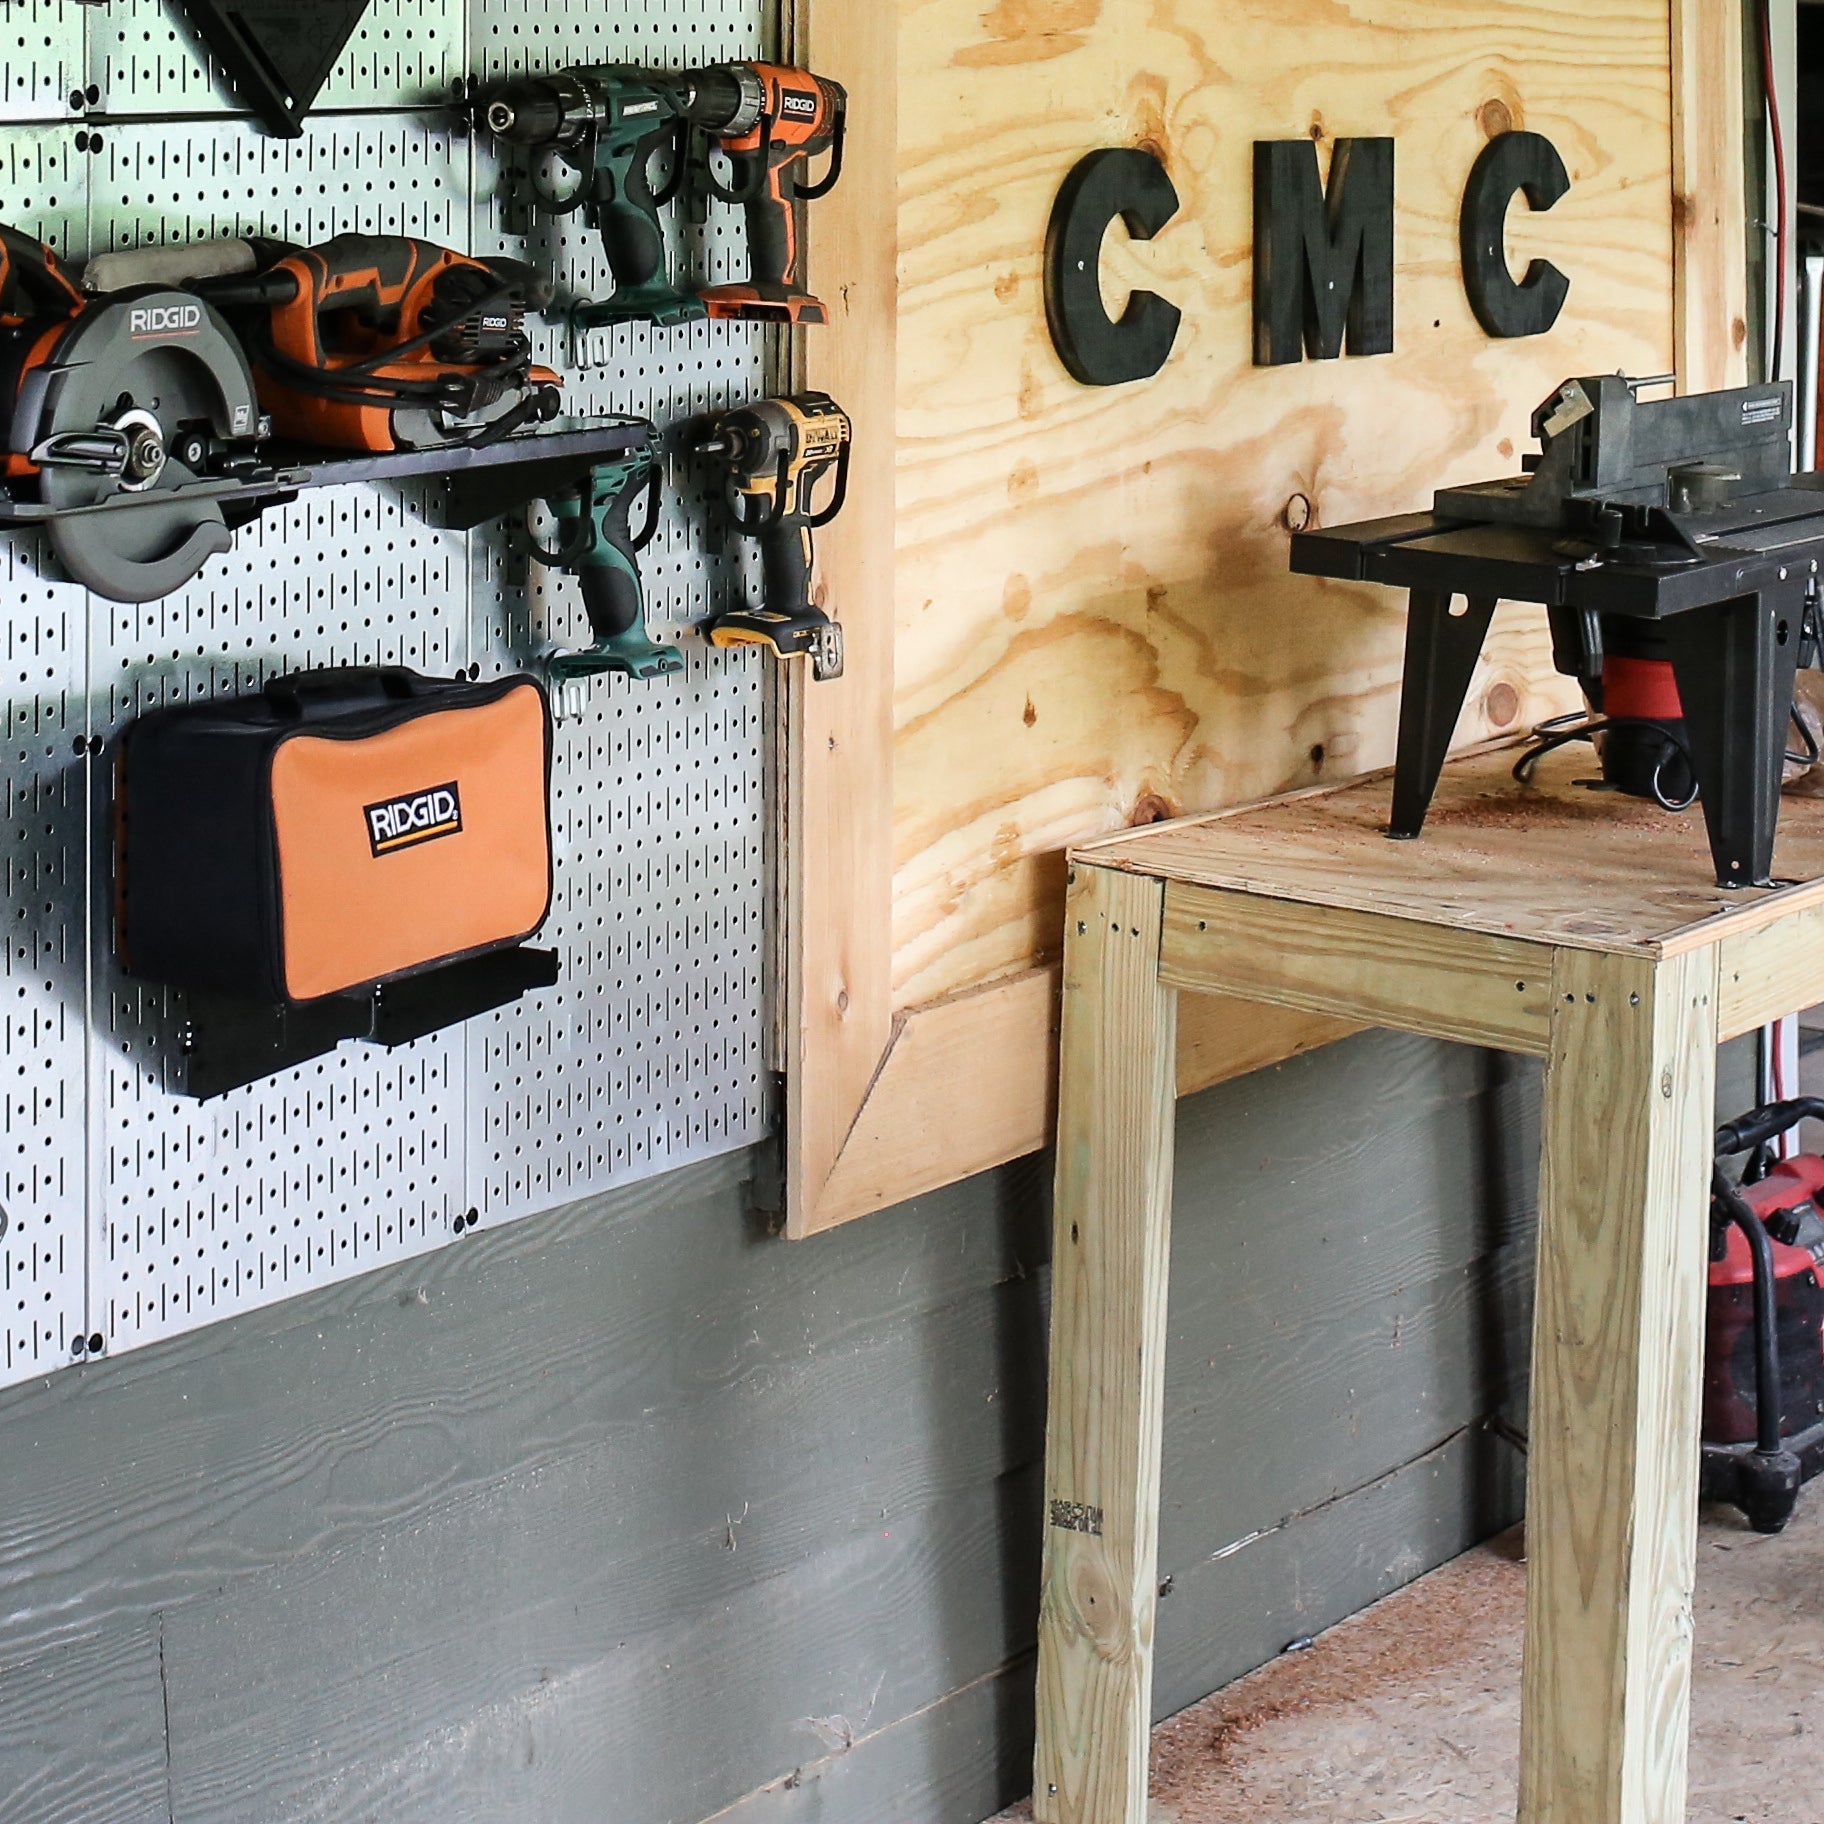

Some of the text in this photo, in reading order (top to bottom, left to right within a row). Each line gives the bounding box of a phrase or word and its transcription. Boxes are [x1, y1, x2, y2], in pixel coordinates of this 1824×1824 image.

[784, 96, 815, 113] RIDGID
[130, 305, 201, 332] RIDGID
[482, 317, 507, 328] RIDGID
[370, 790, 456, 841] RIDGID
